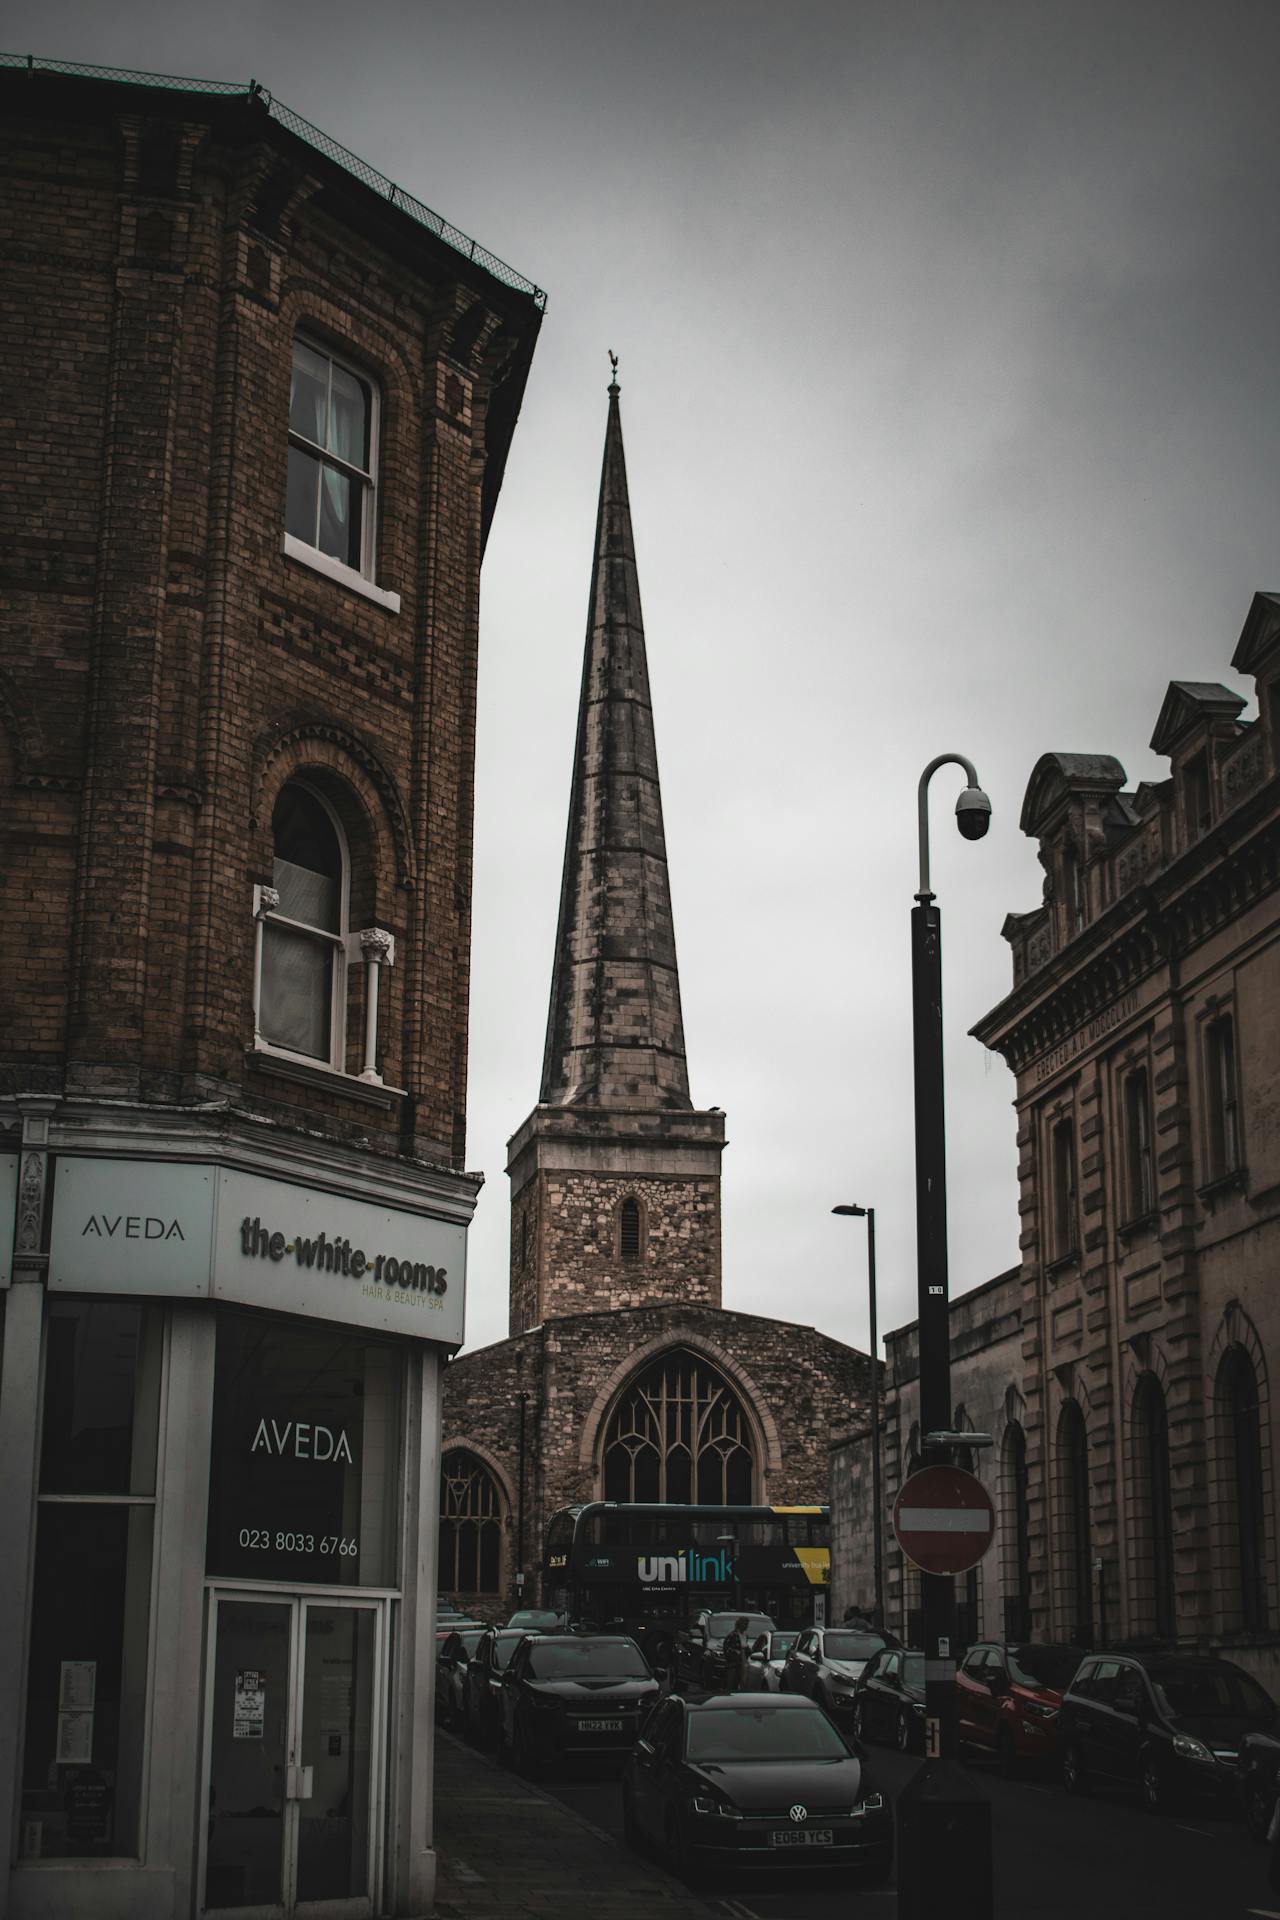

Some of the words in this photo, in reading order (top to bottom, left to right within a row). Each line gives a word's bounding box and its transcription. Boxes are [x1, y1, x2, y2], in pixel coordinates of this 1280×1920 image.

[82, 1215, 185, 1240] AVEDA
[362, 1285, 383, 1299] HAIR
[385, 1290, 391, 1301] &
[395, 1291, 425, 1308] BEAUTY
[429, 1298, 443, 1311] SPA
[251, 1418, 353, 1464] AVEDA
[239, 1529, 270, 1549] 023
[276, 1532, 315, 1553] 8033
[320, 1536, 358, 1556] 6766
[808, 1831, 831, 1843] YCS
